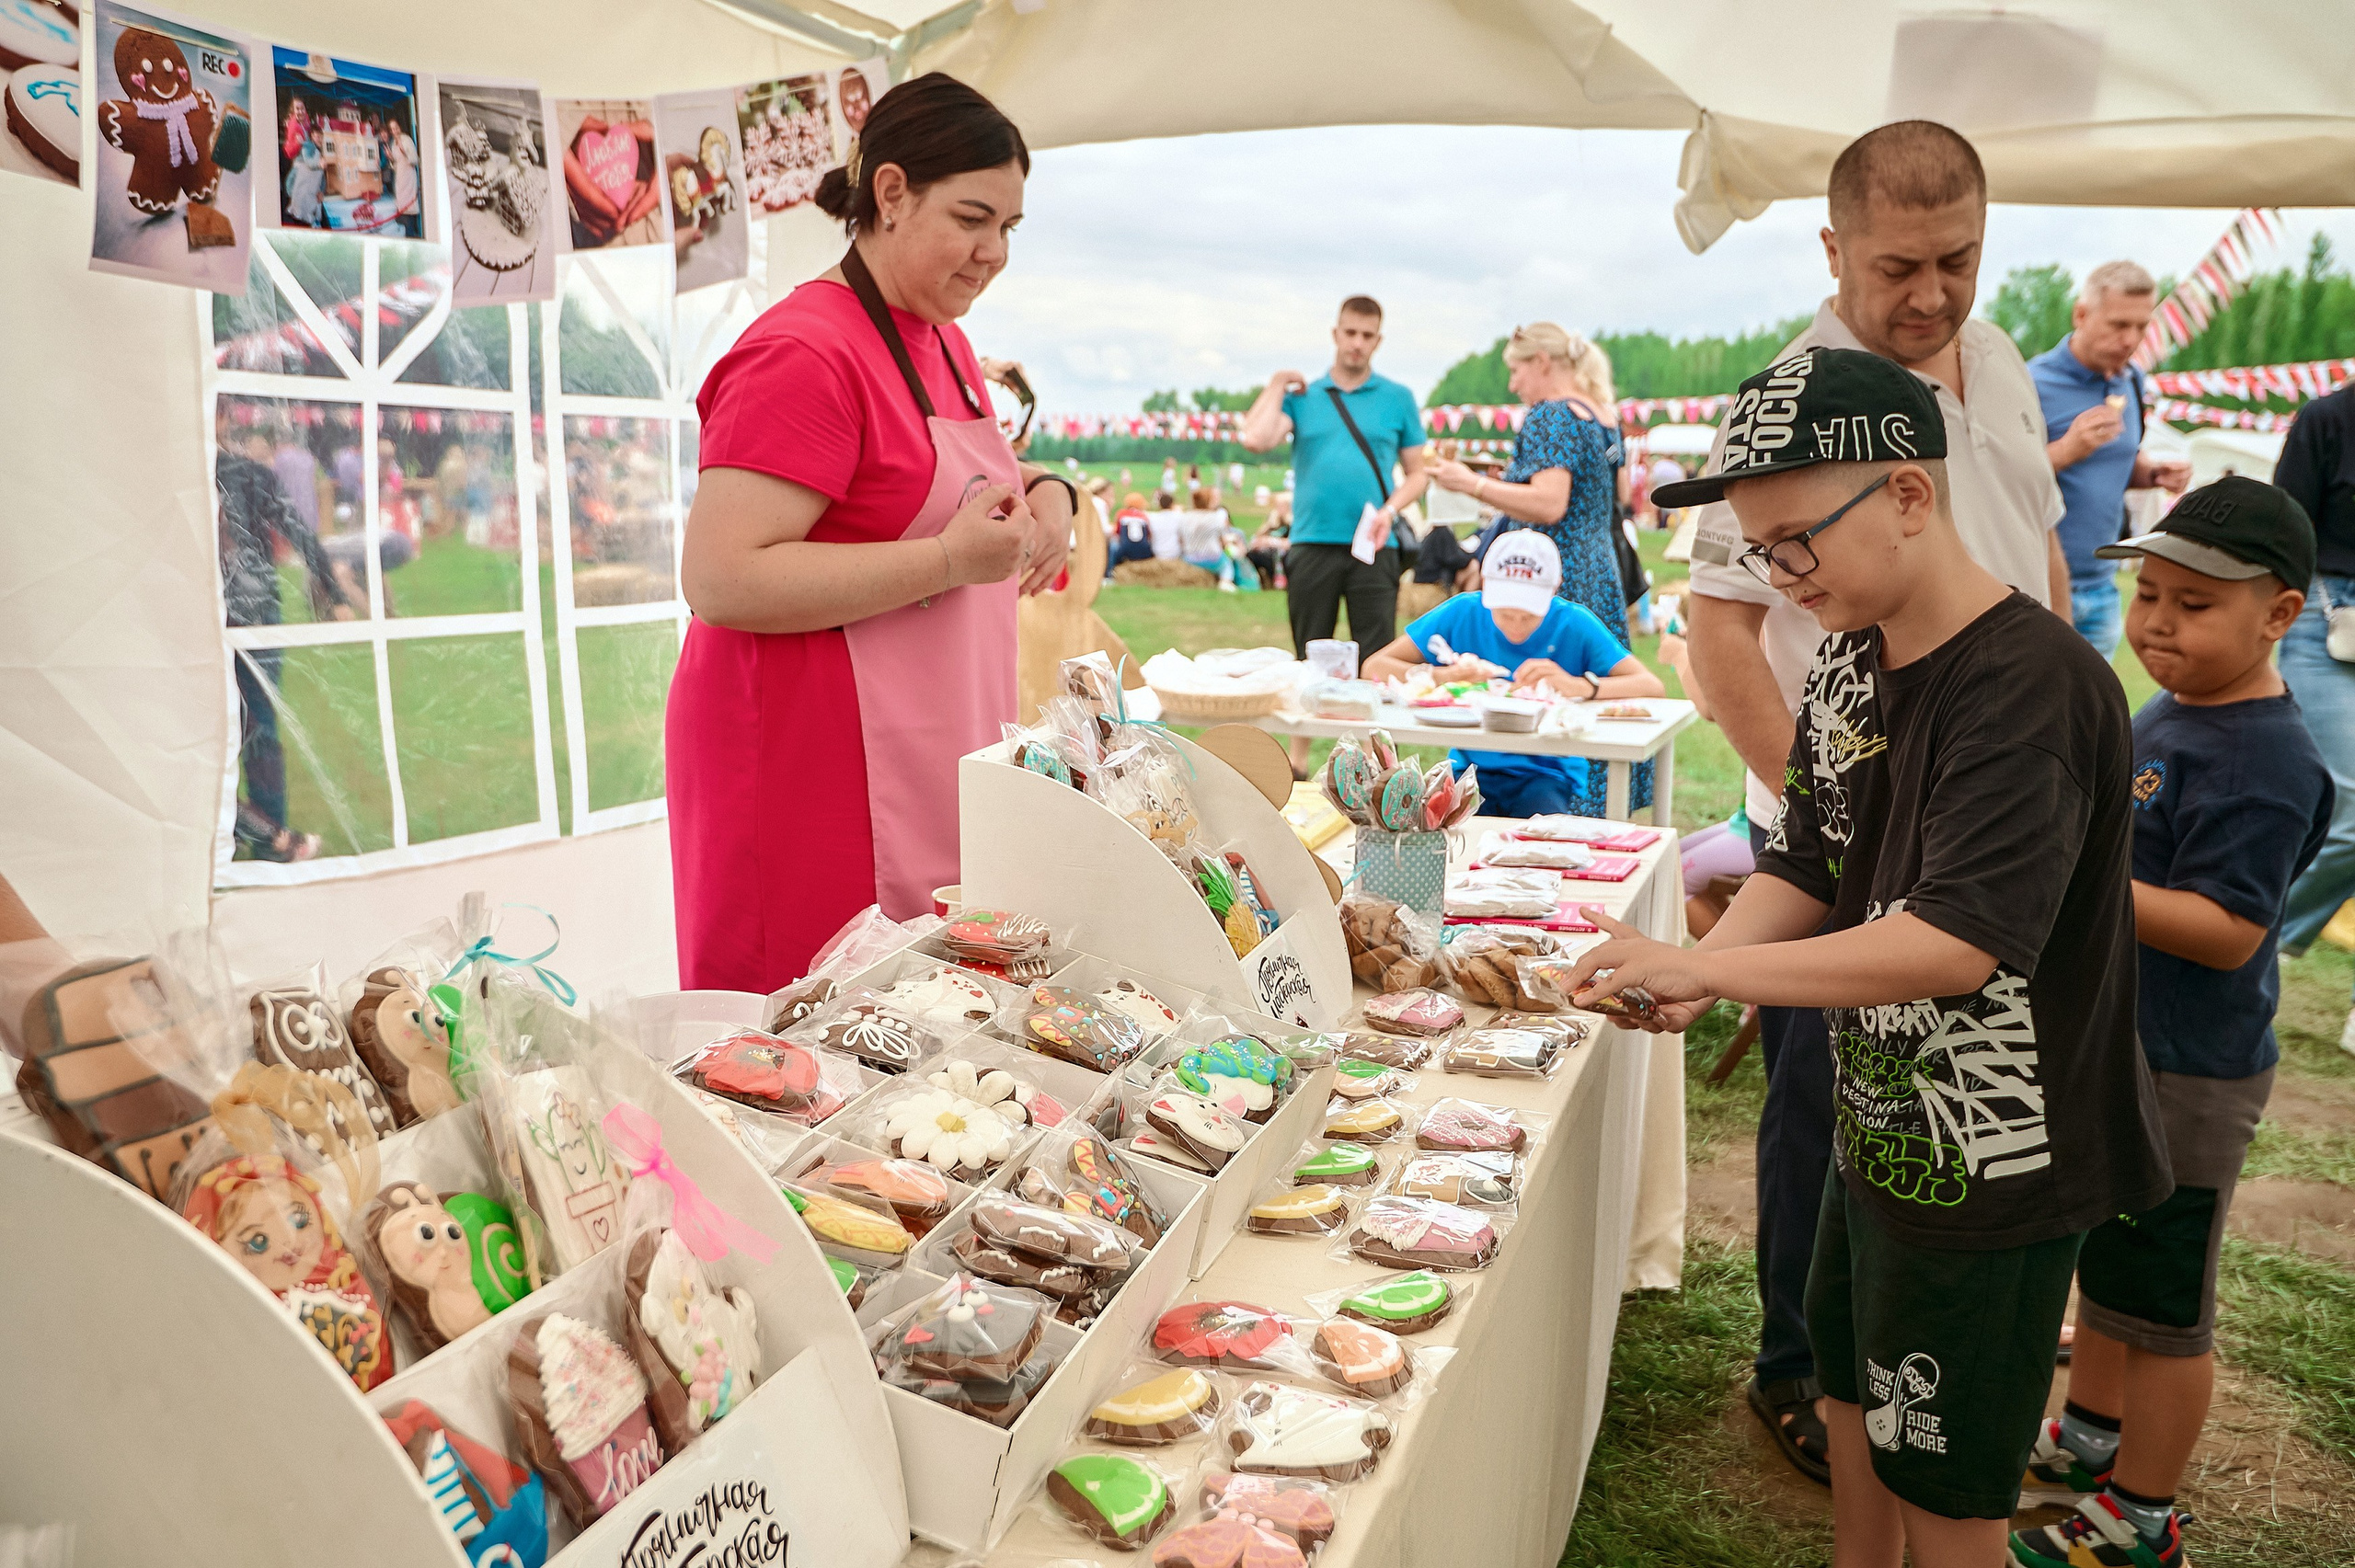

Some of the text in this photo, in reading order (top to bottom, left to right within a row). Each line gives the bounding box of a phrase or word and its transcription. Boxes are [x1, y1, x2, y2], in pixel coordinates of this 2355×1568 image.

[202, 52, 226, 75] REC
[1852, 1076, 1883, 1099] NEW
[1855, 1110, 1890, 1129] TION
[1867, 1357, 1896, 1387] THINK
[1868, 1378, 1890, 1401] LESS
[1906, 1410, 1942, 1434] RIDE
[1906, 1427, 1948, 1453] MORE
